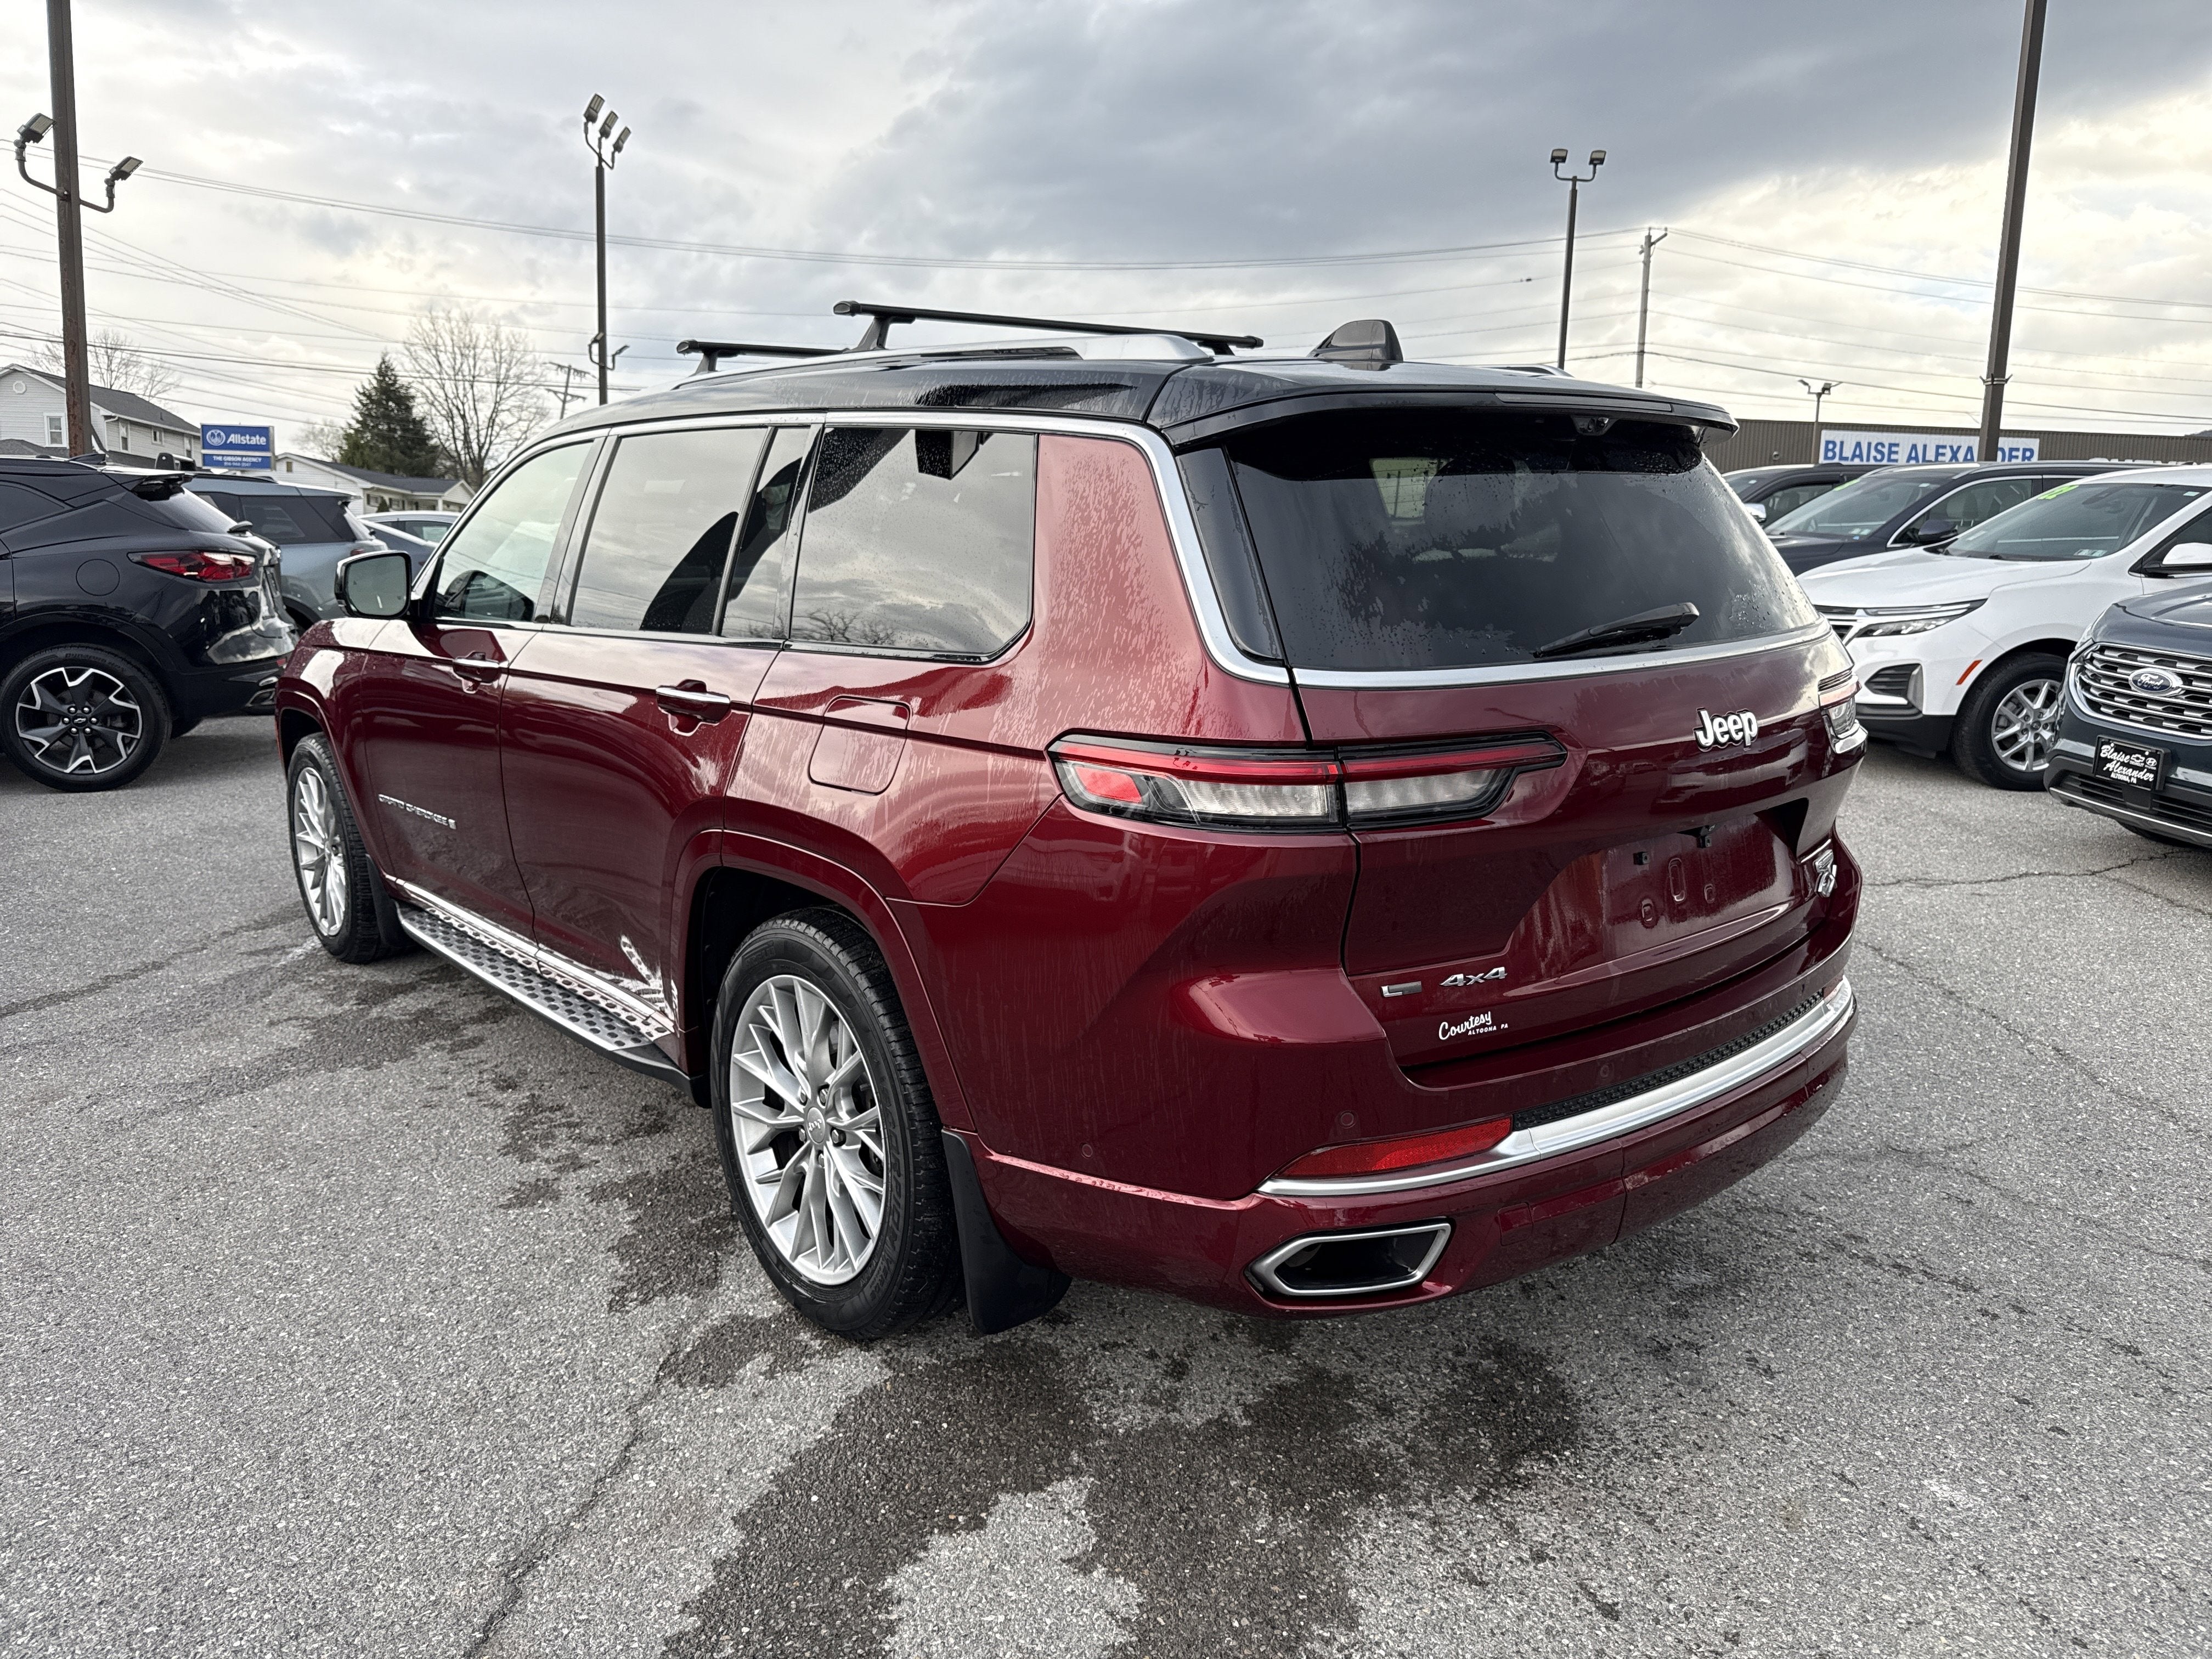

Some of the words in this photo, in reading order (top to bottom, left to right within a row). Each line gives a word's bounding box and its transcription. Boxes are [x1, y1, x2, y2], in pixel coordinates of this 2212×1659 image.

[227, 433, 267, 445] Allstate
[1824, 440, 1900, 463] BLAISE
[1905, 443, 2035, 463] ALEXADER
[2137, 673, 2164, 690] Ford
[1693, 707, 1758, 752] Jeep
[2100, 744, 2130, 763] Blaise
[2103, 760, 2154, 782] Alexander
[1438, 1011, 1492, 1040] Courtesy
[1468, 1025, 1497, 1035] ALTOONA
